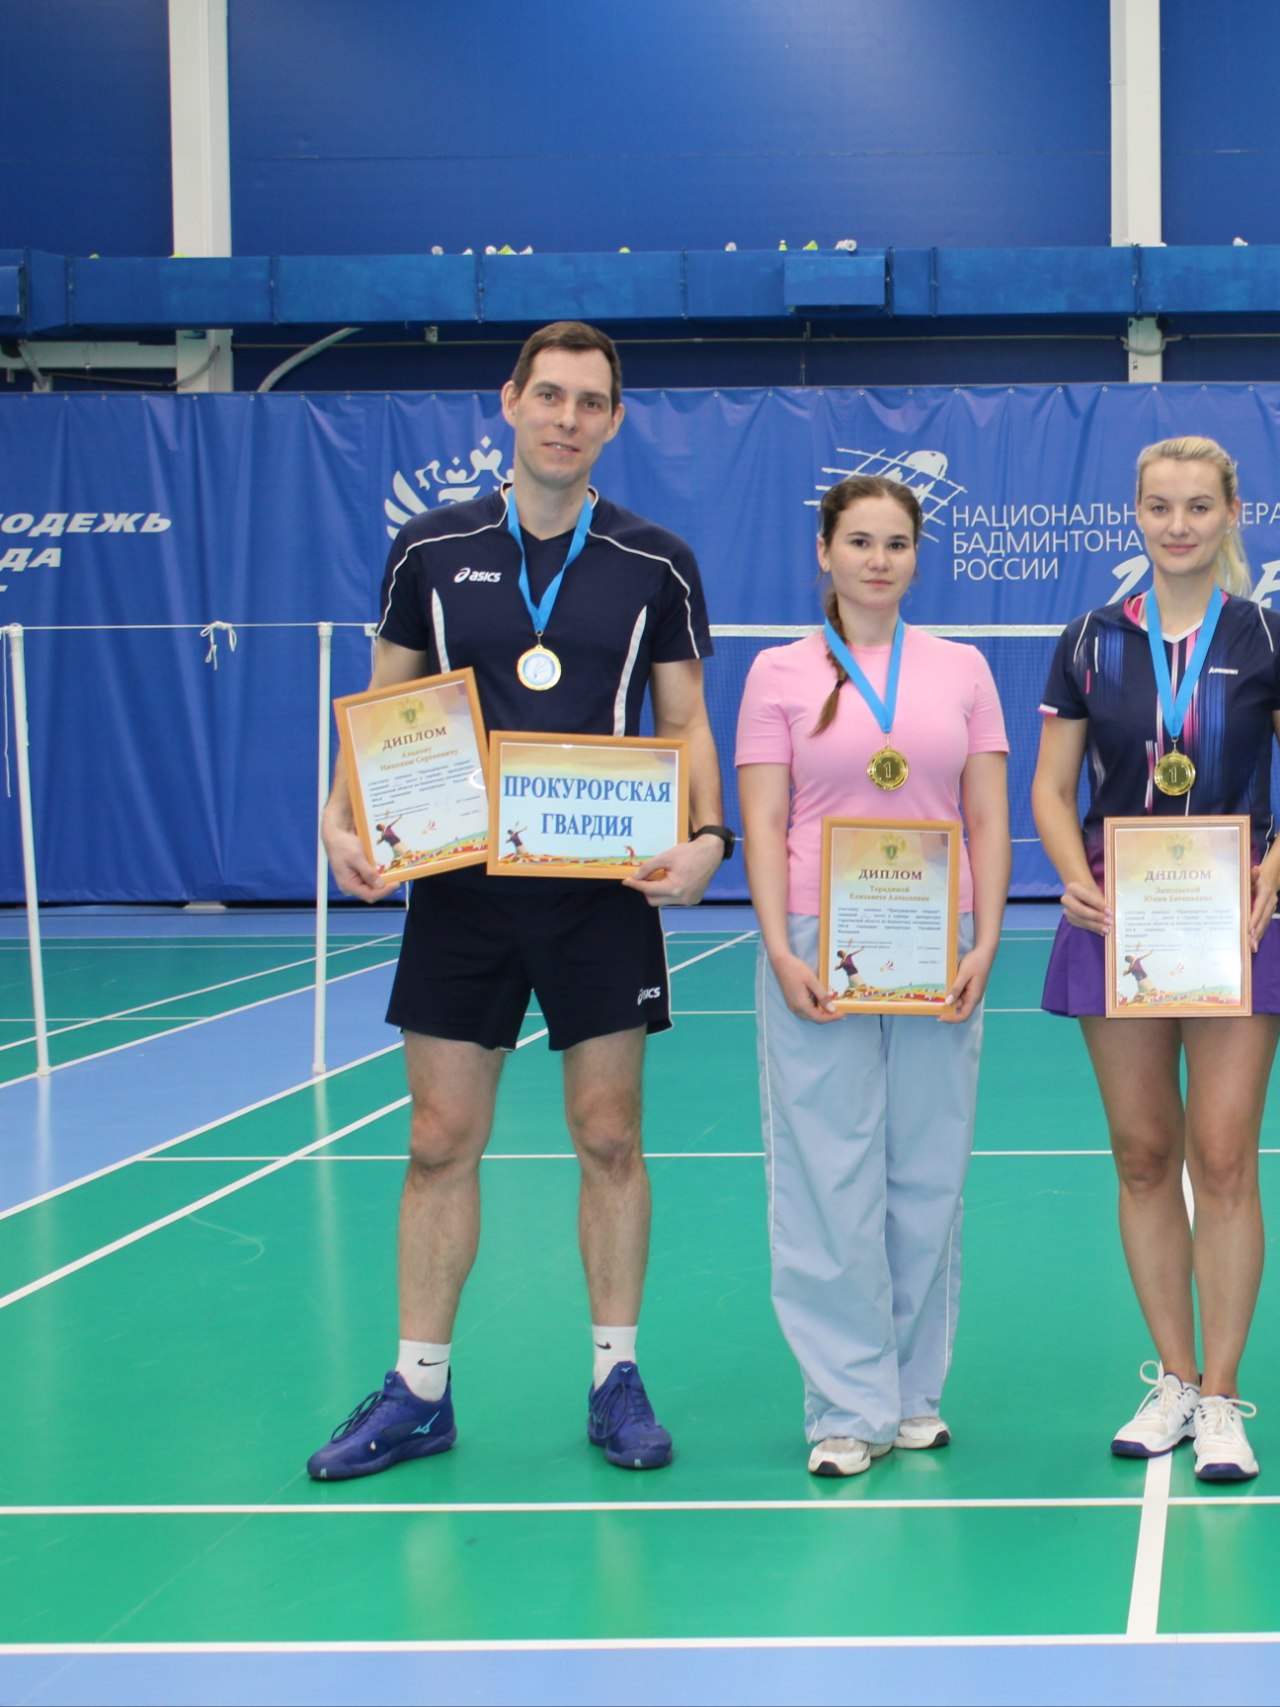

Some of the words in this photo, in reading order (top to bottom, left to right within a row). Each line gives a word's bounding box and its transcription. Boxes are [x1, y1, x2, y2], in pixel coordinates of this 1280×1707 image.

[0, 513, 172, 537] ОДЕЖЬ
[952, 529, 1144, 558] БАДМИНТОНА
[952, 558, 1059, 582] РОССИИ
[382, 726, 447, 752] ДИПЛОМ
[503, 776, 672, 803] ПРОКУРОРСКАЯ
[541, 813, 633, 840] ГВАРДИЯ
[858, 869, 922, 881] ДИПЛОМ
[1144, 870, 1212, 883] ДИПЛОМ
